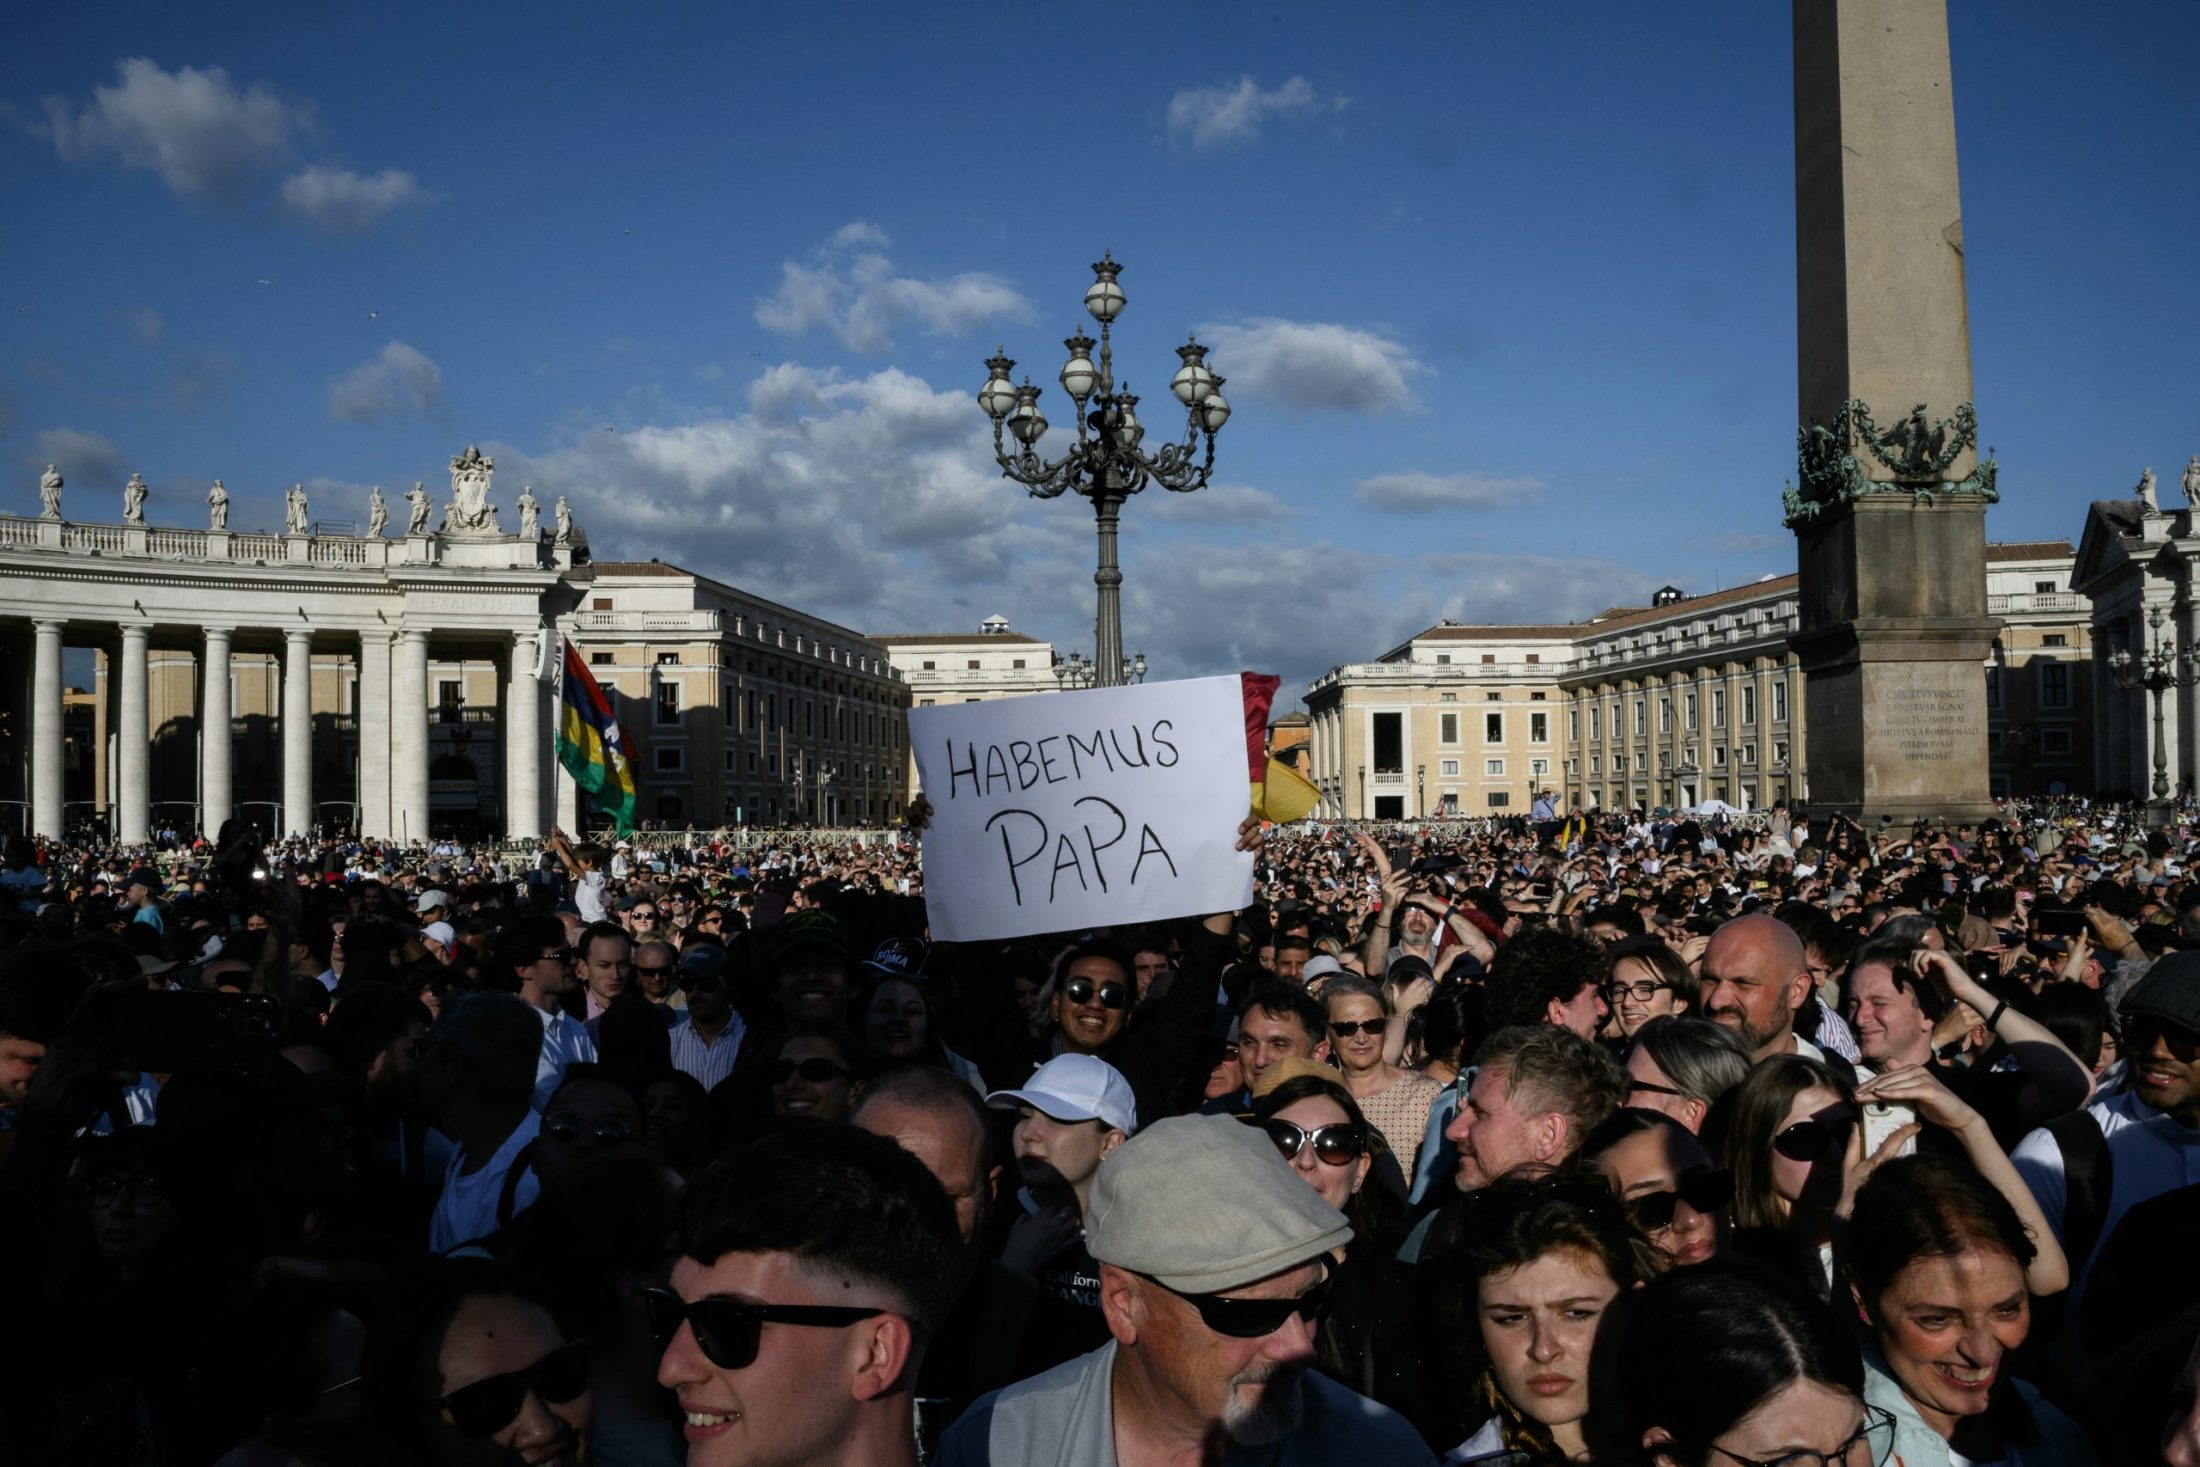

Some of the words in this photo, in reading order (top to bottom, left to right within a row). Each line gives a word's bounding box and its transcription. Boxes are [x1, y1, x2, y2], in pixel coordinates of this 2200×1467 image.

[1930, 703, 1965, 712] REGNAT
[947, 720, 1179, 800] HABEMUS
[985, 796, 1178, 907] PAPA
